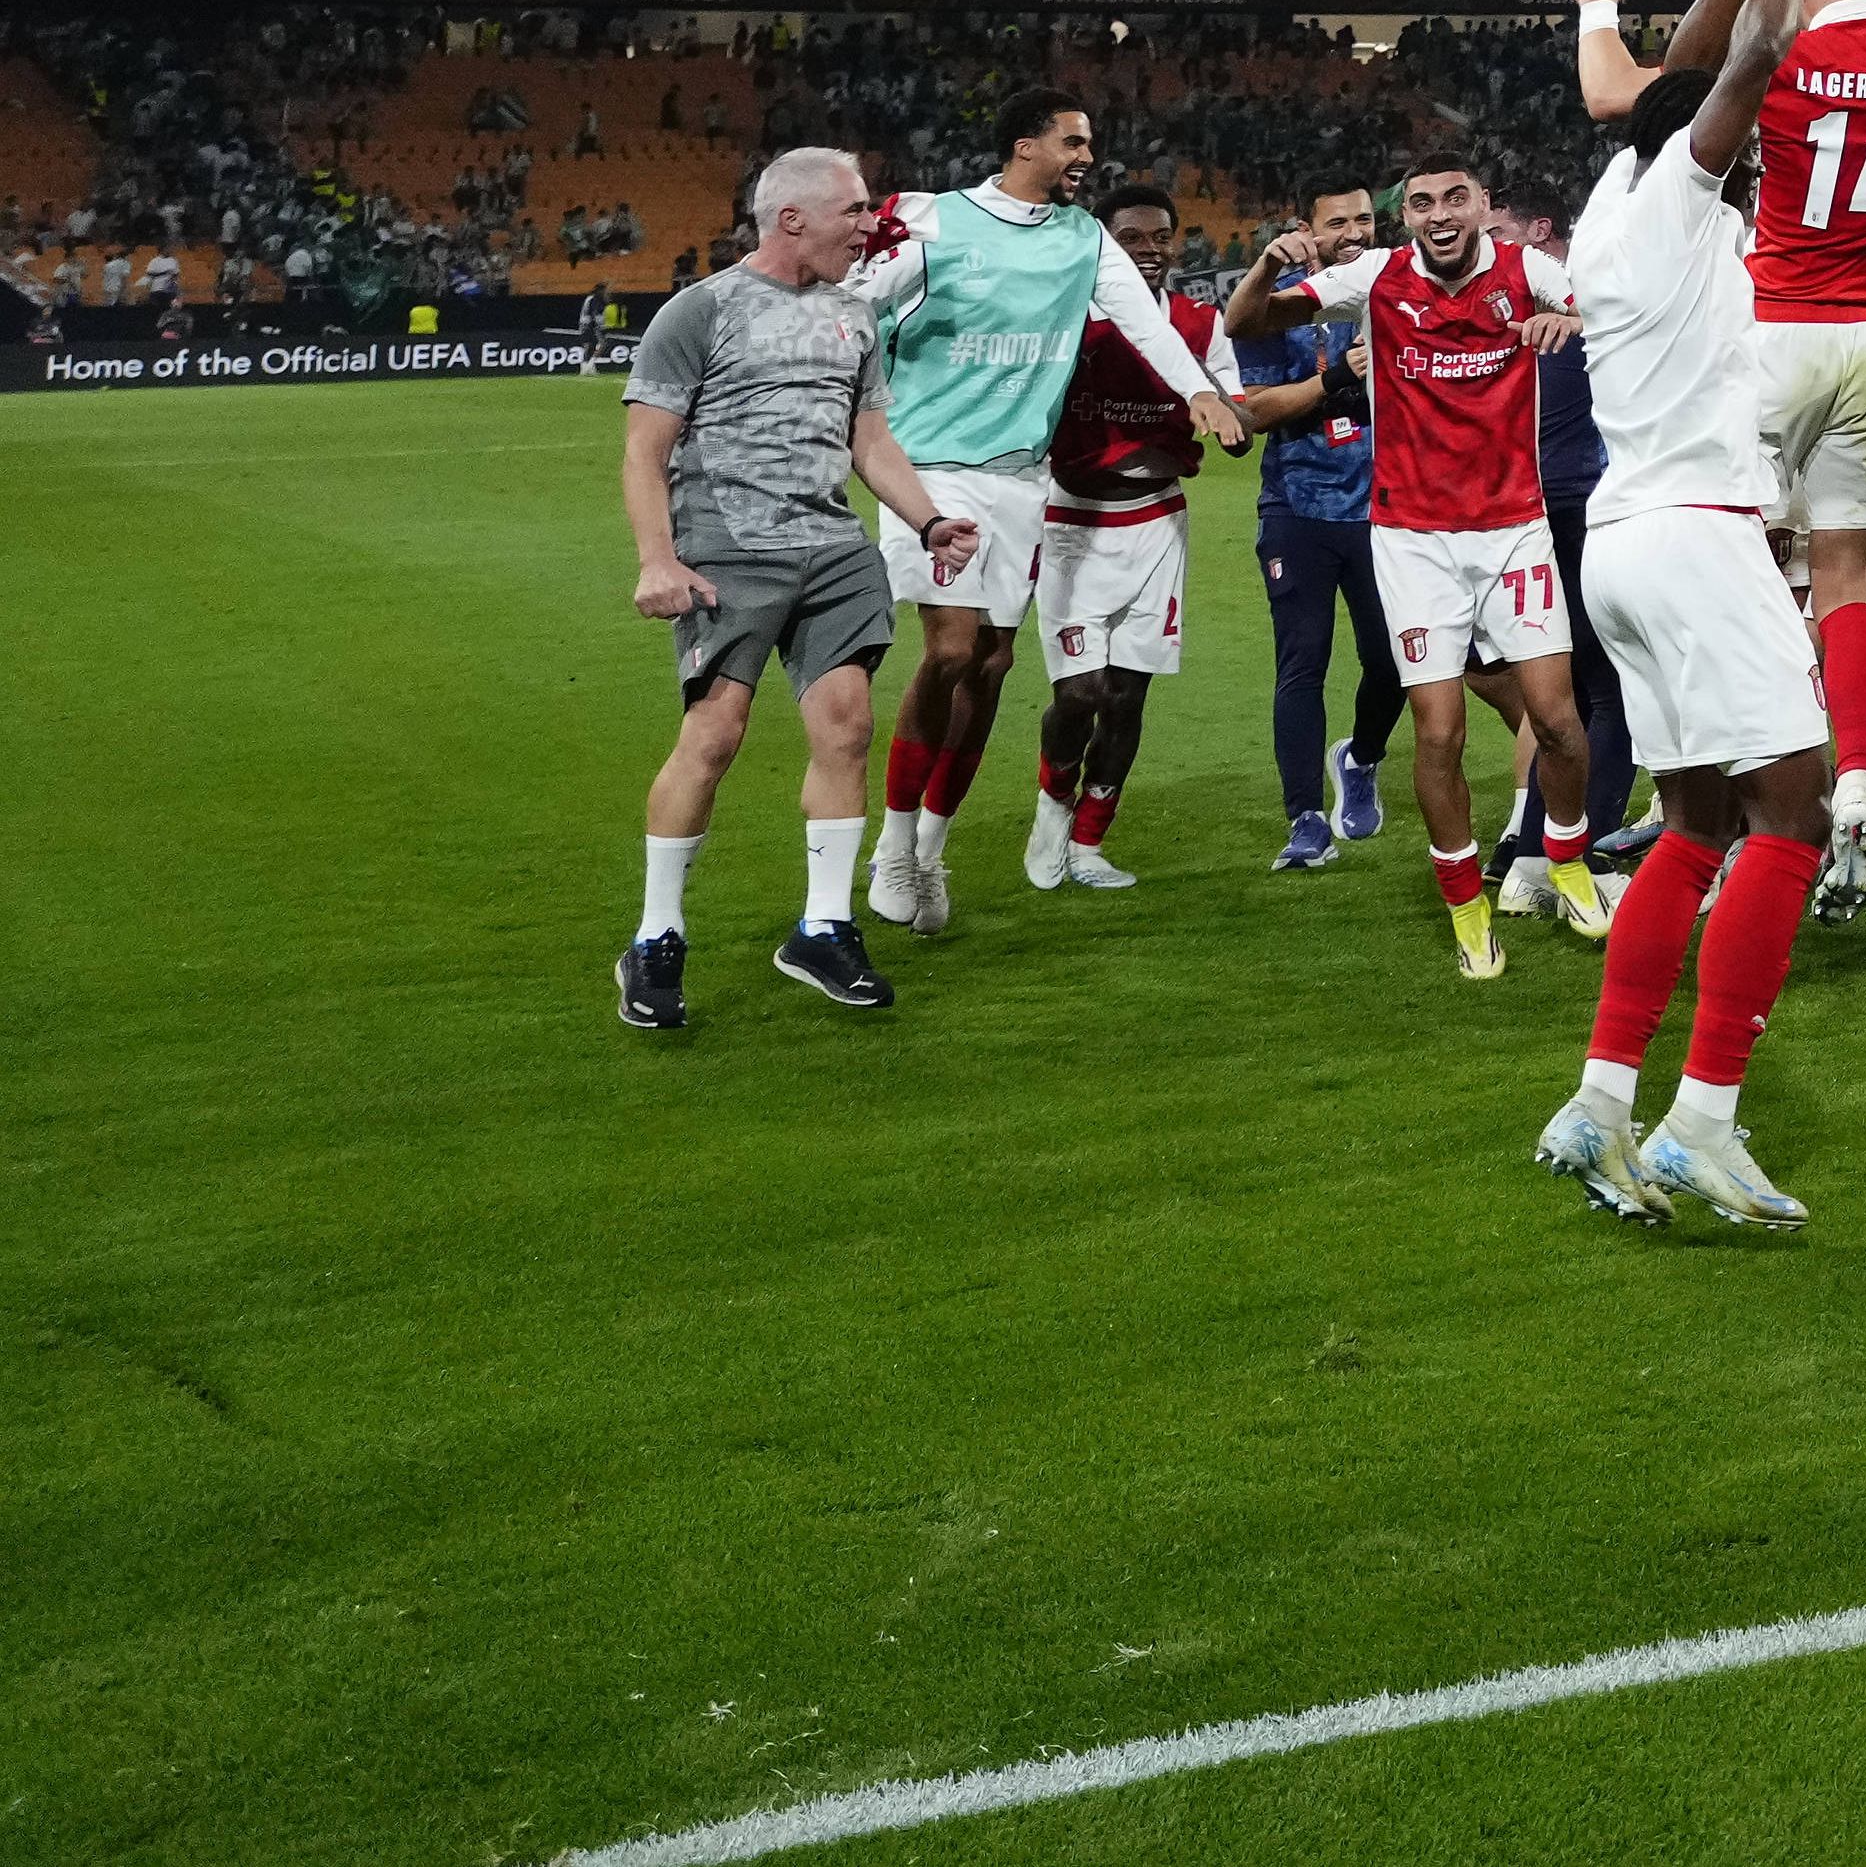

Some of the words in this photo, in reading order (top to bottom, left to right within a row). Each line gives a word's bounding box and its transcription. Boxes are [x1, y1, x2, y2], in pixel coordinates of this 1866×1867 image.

[46, 353, 144, 381] Home
[152, 348, 190, 378] of
[198, 347, 252, 377] the
[261, 345, 378, 373] Official
[387, 342, 472, 371] UEFA
[480, 341, 585, 373] Europa
[950, 330, 1071, 367] #FOOTBLL
[1432, 344, 1519, 365] Portuguese
[1431, 363, 1463, 379] Red
[1464, 361, 1506, 378] Cross
[1502, 563, 1554, 618] 77
